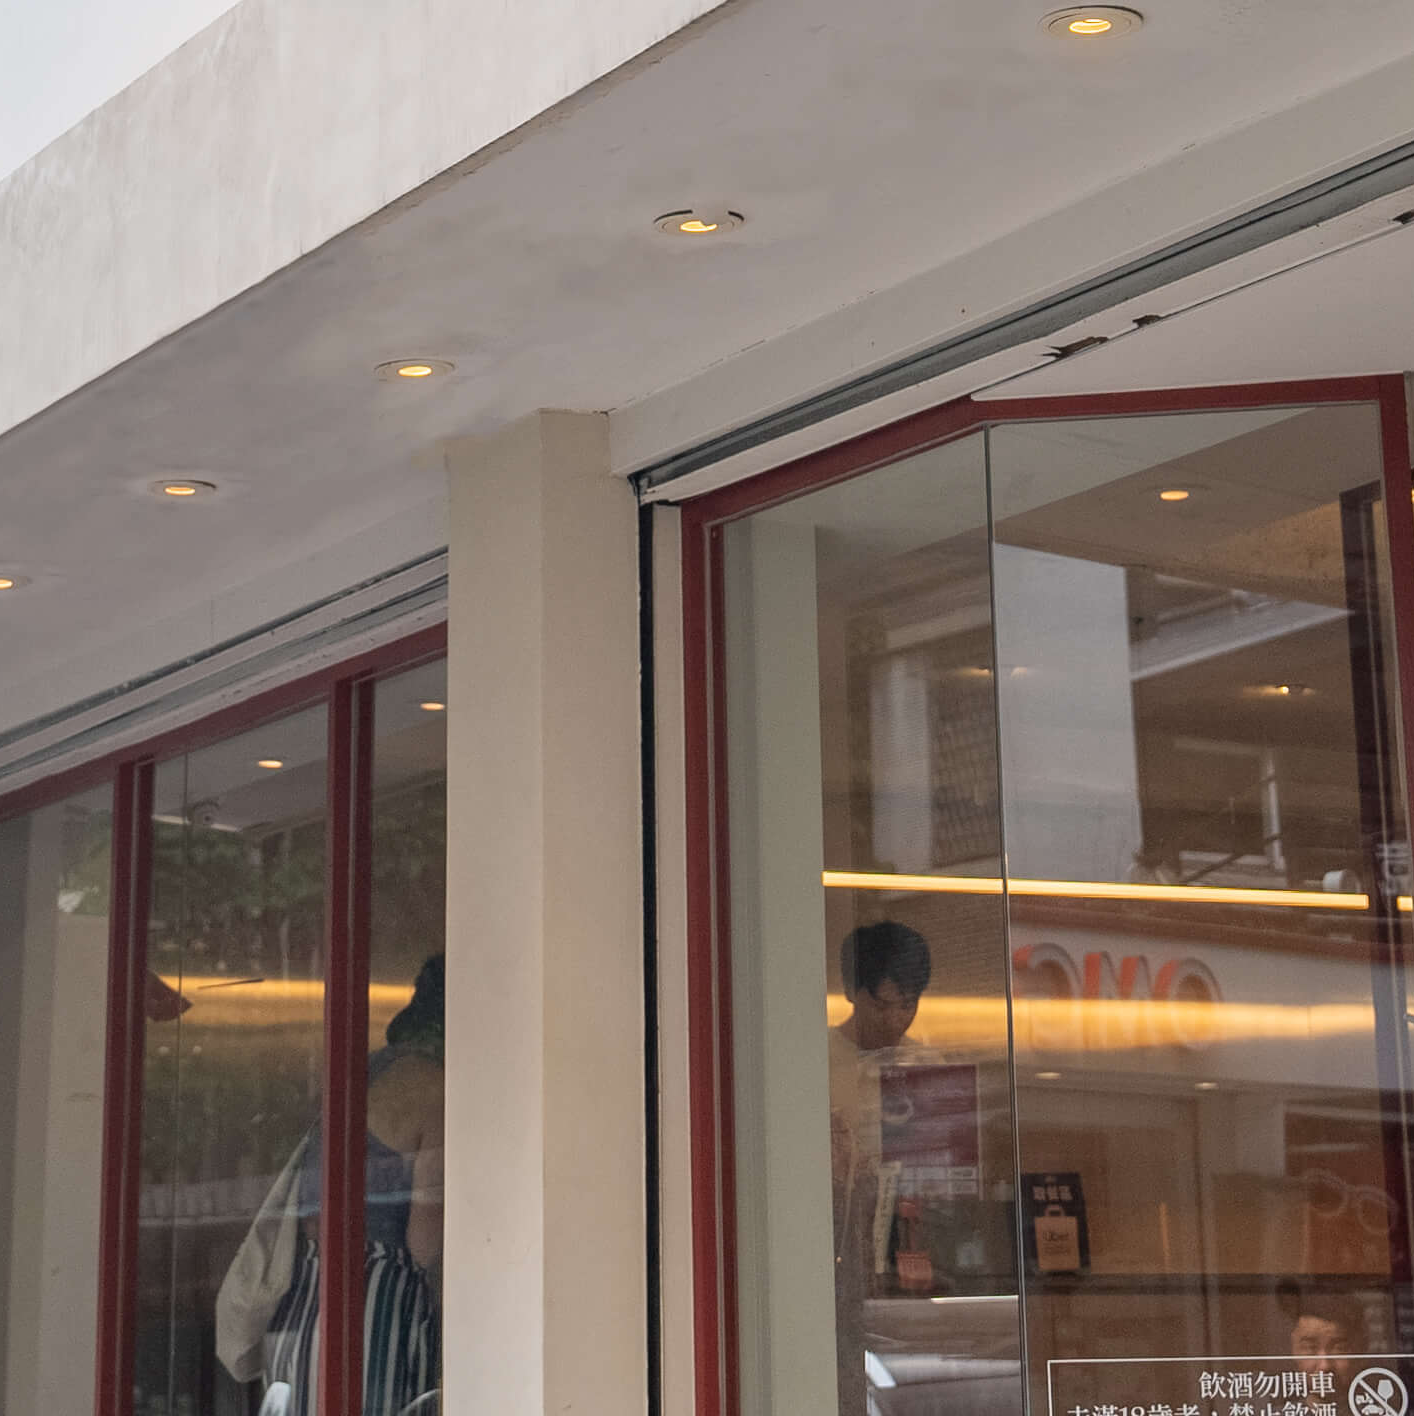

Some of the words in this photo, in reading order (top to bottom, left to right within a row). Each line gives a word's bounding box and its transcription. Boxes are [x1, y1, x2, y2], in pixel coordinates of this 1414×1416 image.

[1199, 1370, 1336, 1399] 飲酒勿開車
